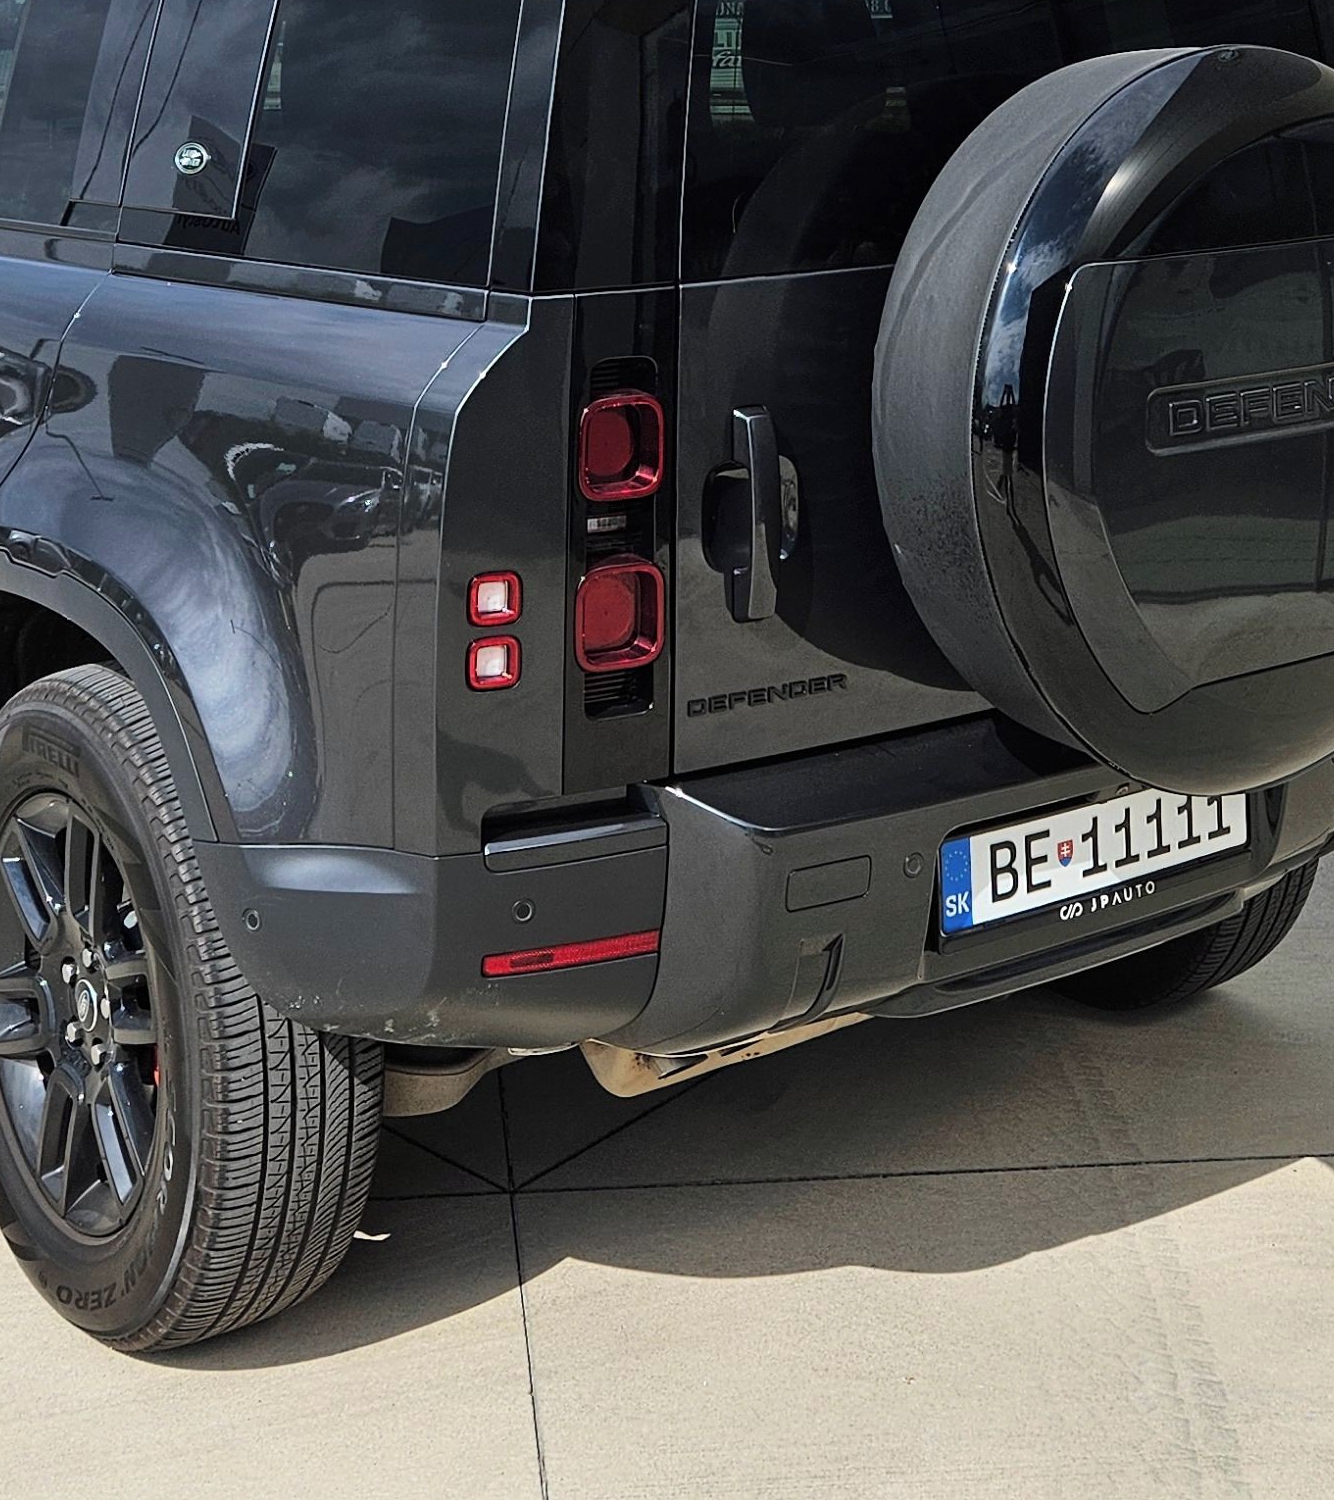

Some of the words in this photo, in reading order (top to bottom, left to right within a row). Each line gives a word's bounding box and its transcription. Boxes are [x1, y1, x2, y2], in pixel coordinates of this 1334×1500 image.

[687, 672, 848, 718] DEFENDER
[945, 891, 970, 917] SK
[990, 829, 1052, 904] BE
[57, 1284, 120, 1312] ZERO
